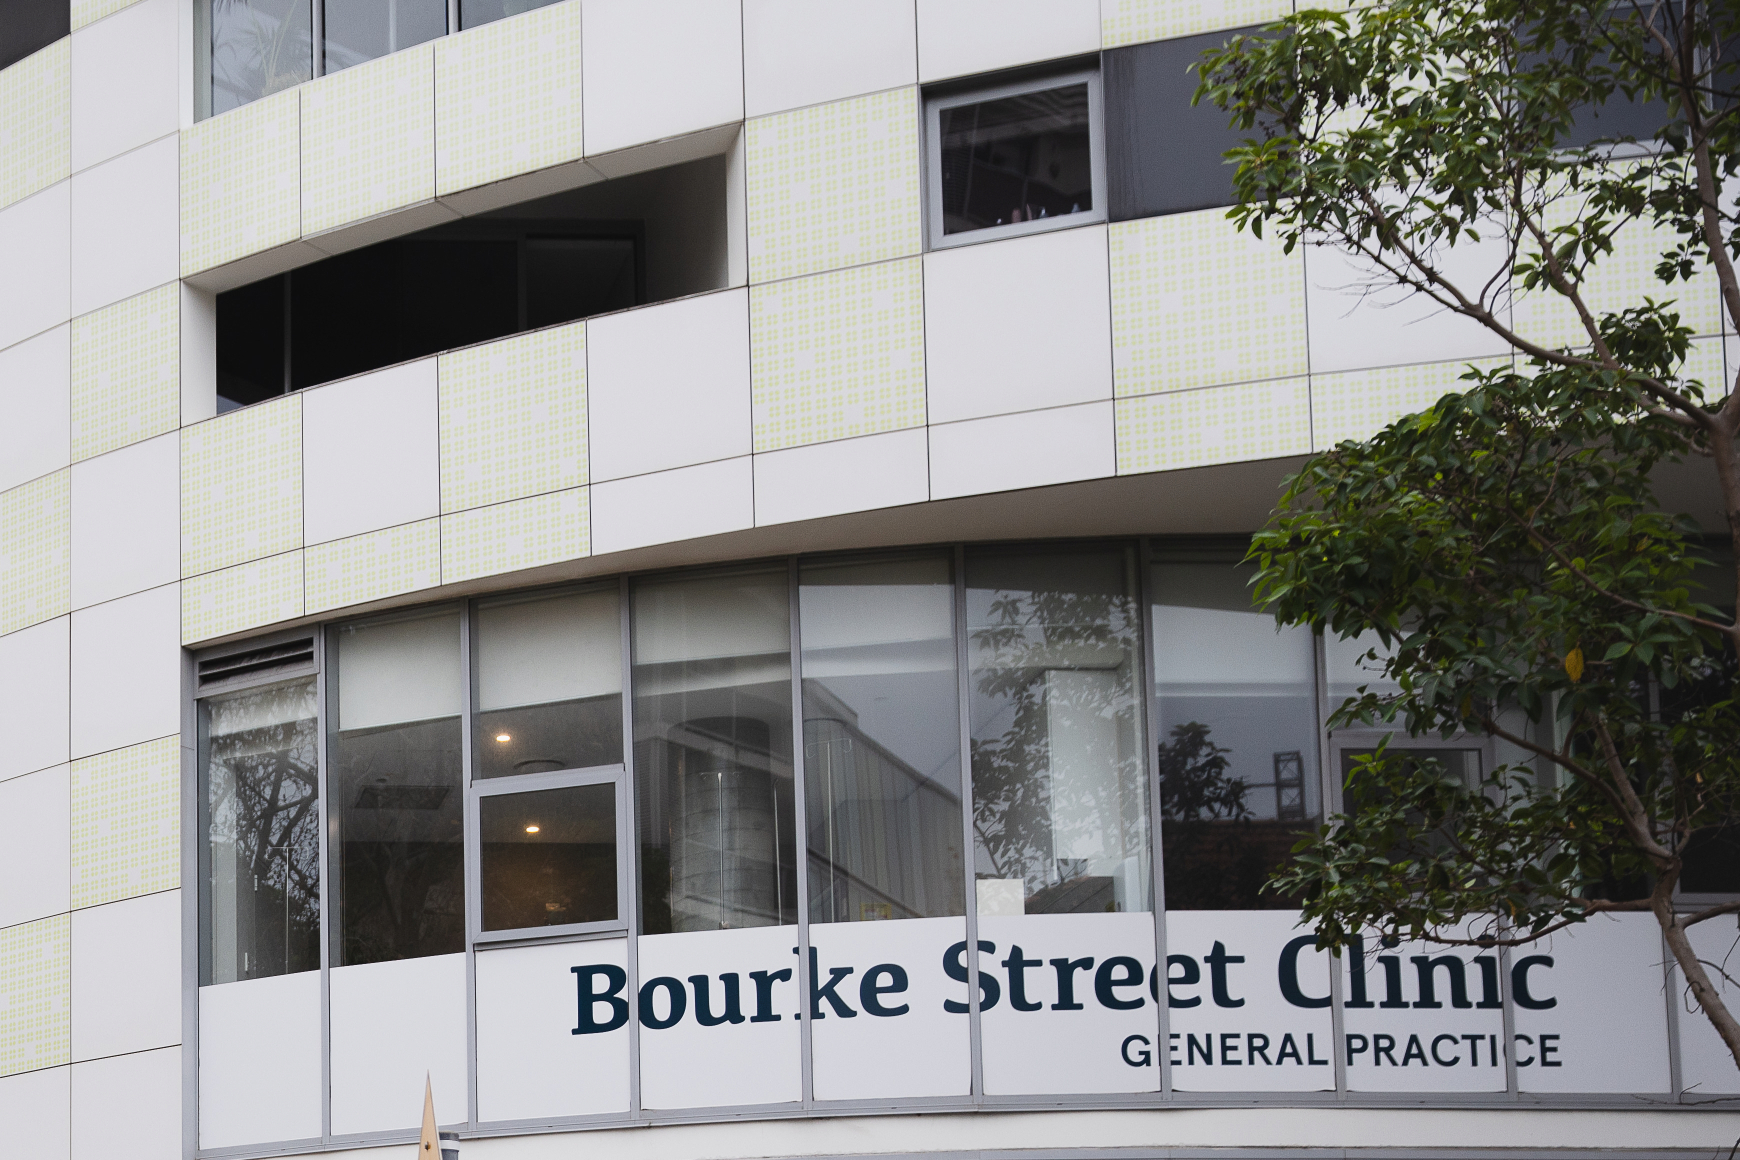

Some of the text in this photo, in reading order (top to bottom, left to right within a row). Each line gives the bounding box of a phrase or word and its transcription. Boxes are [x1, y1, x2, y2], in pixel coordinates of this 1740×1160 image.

[570, 933, 1559, 1036] Bourke Street Clinic
[1121, 1033, 1563, 1068] GENERAL PRACTICE
